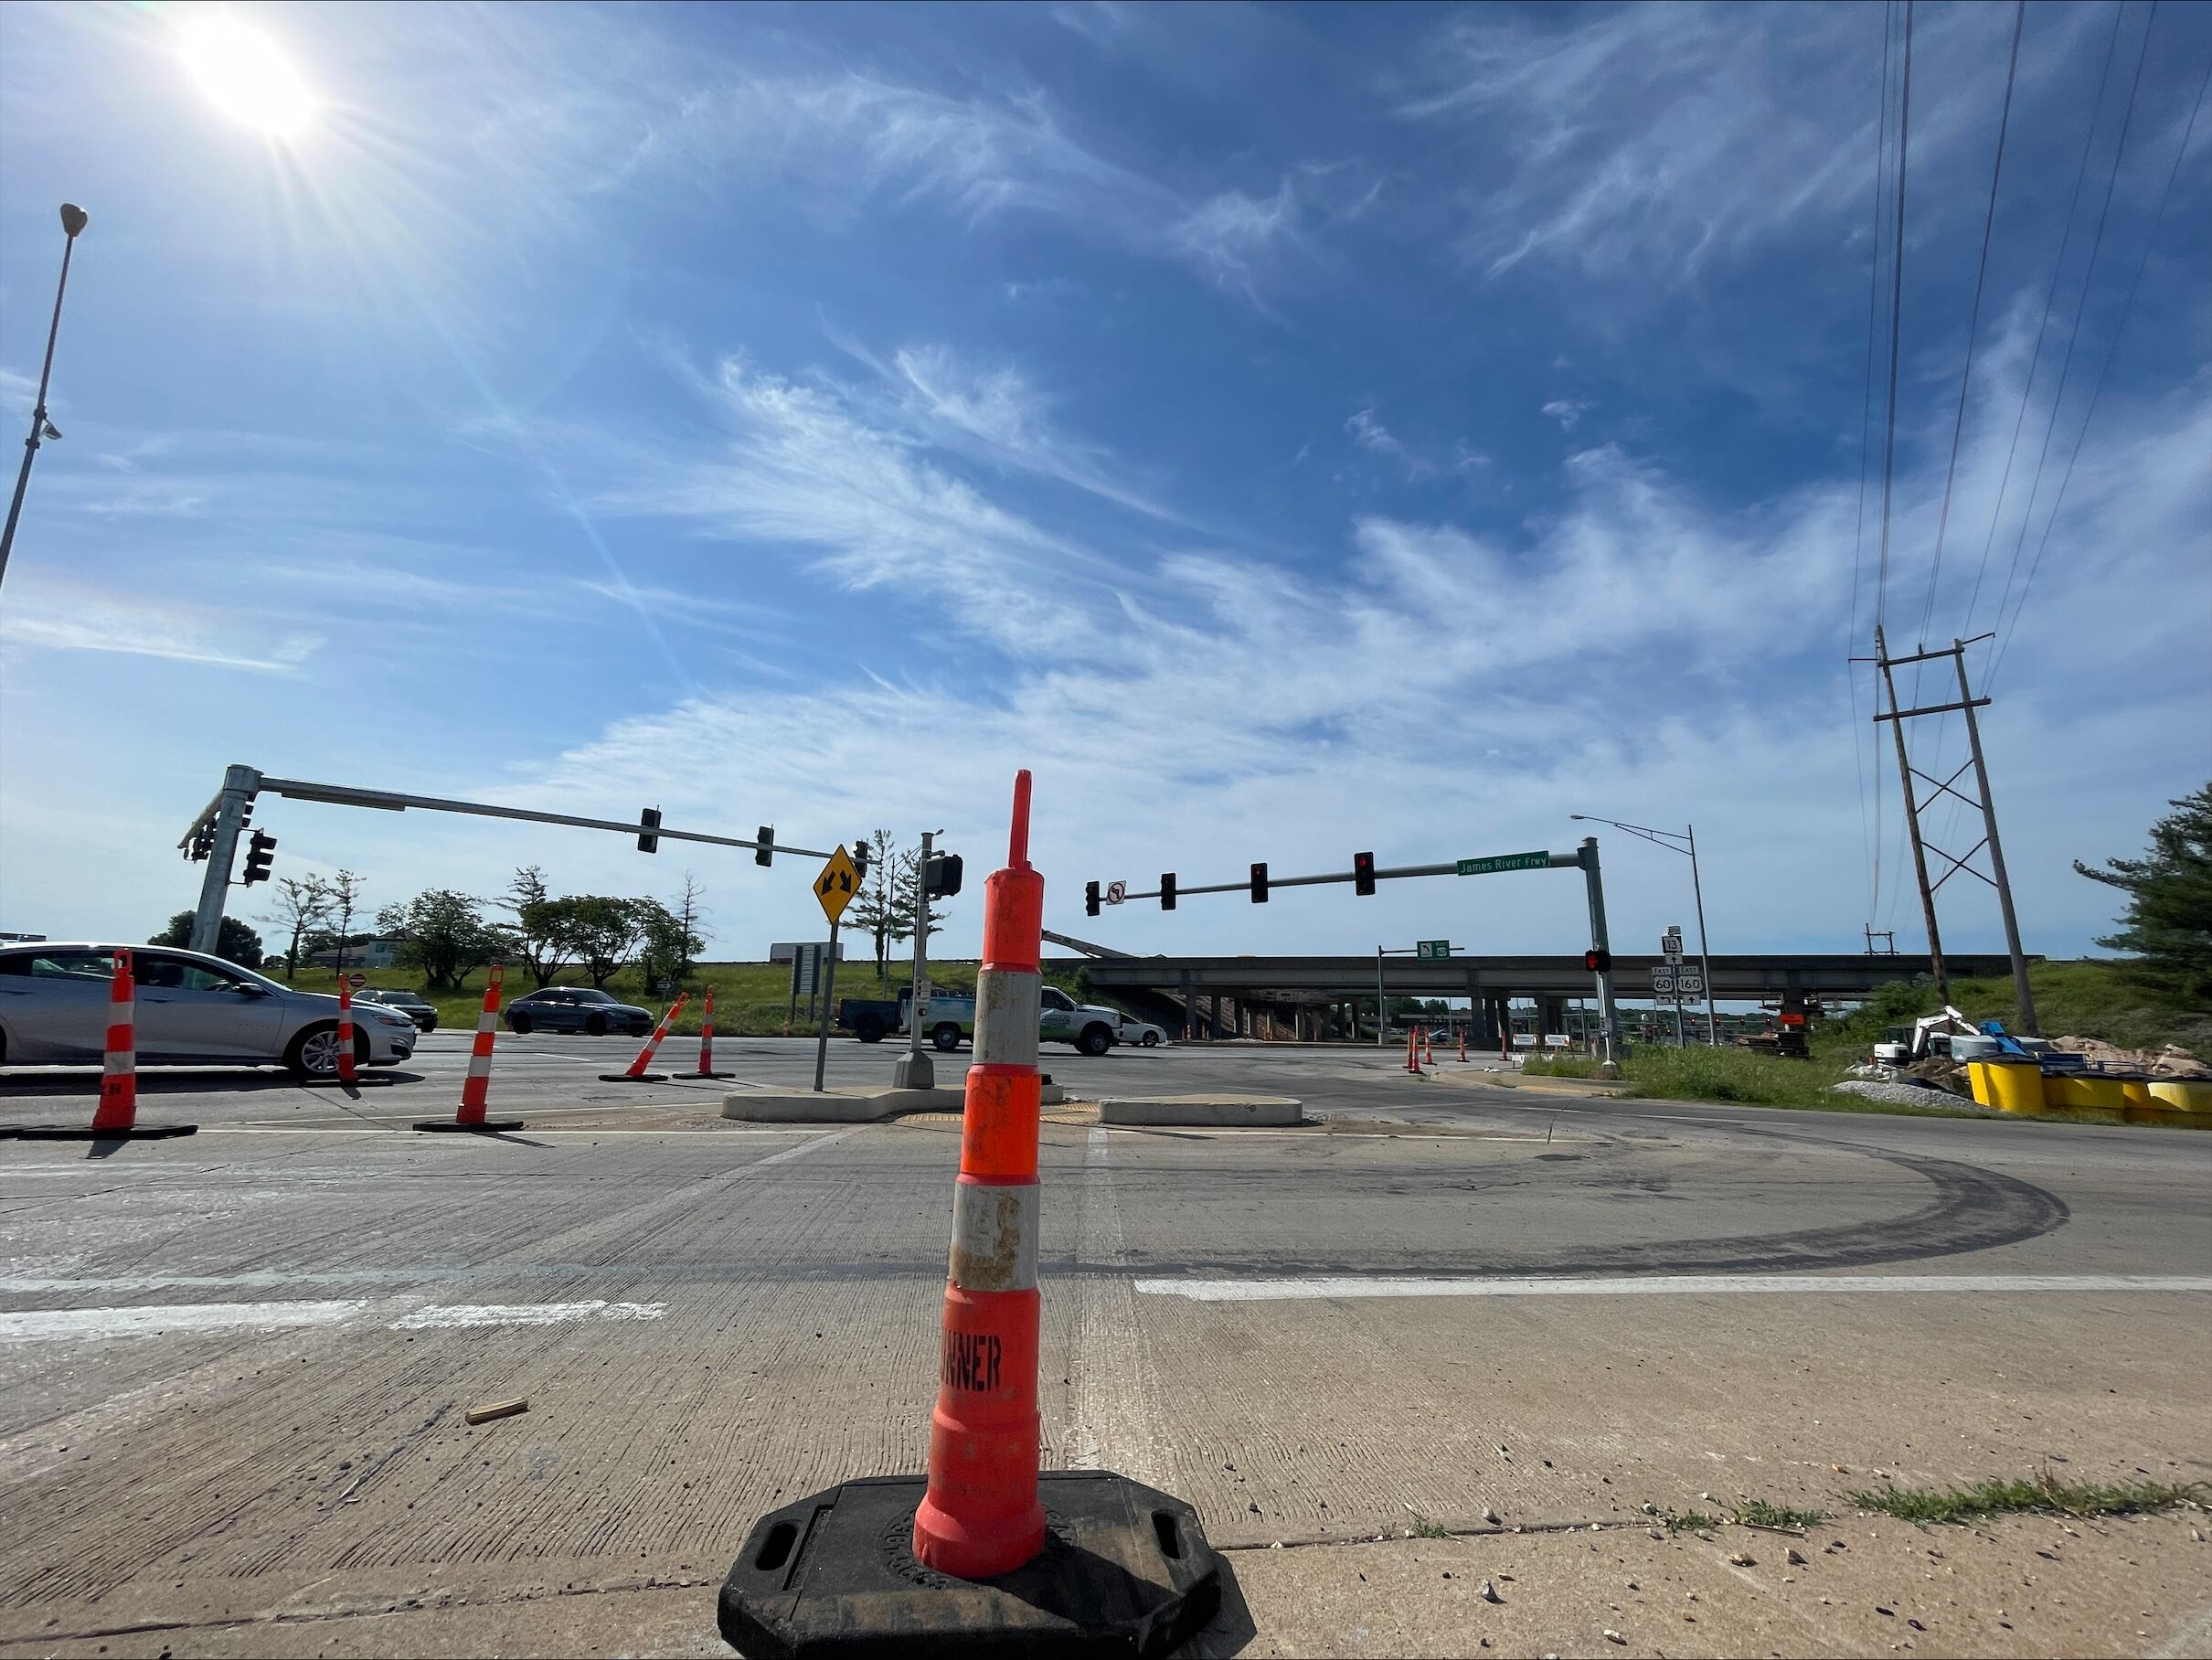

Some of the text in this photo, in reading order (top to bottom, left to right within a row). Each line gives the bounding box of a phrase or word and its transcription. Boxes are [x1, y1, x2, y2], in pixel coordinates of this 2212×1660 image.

[1461, 857, 1547, 874] James River Frwy
[1667, 940, 1677, 950] 13
[1656, 980, 1671, 989] 60
[1681, 979, 1700, 988] 160
